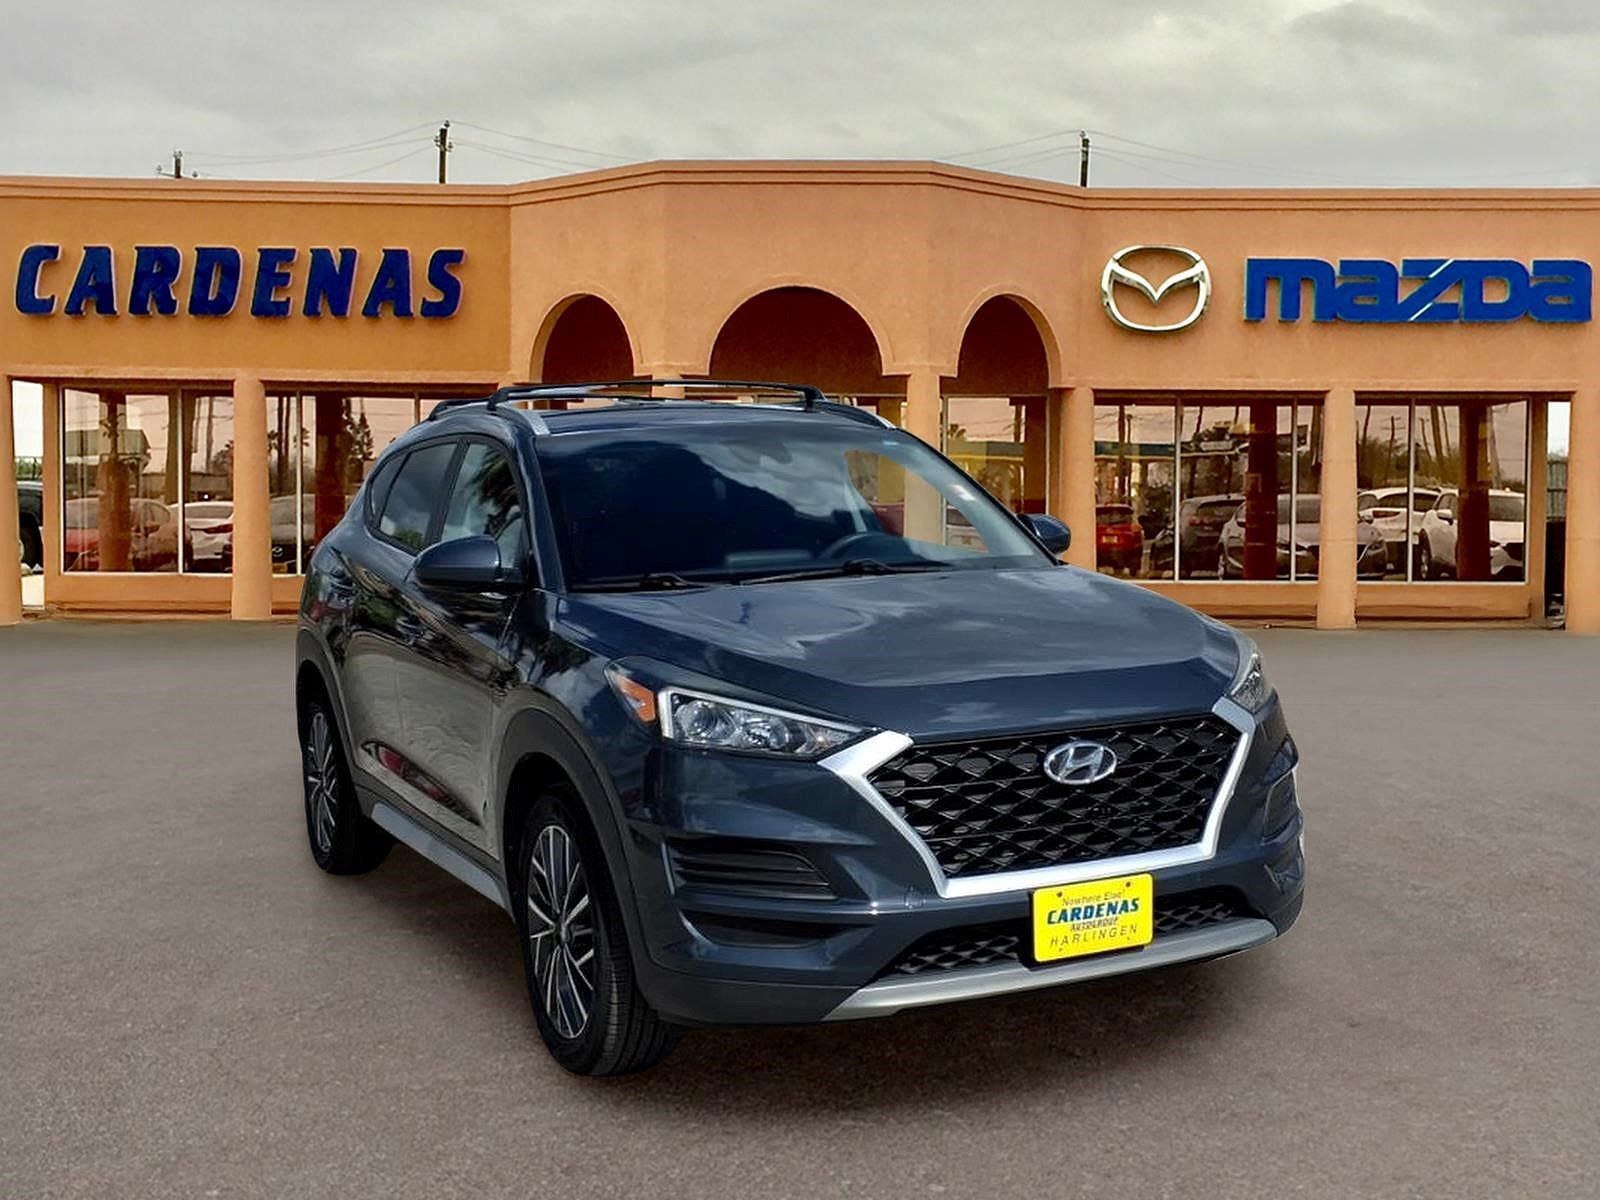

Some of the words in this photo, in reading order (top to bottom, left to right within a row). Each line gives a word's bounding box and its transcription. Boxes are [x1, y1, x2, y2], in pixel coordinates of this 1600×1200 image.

[15, 244, 467, 319] CARDENAS
[1047, 898, 1139, 924] CARDENAS
[1050, 924, 1138, 948] HARLINGEN
